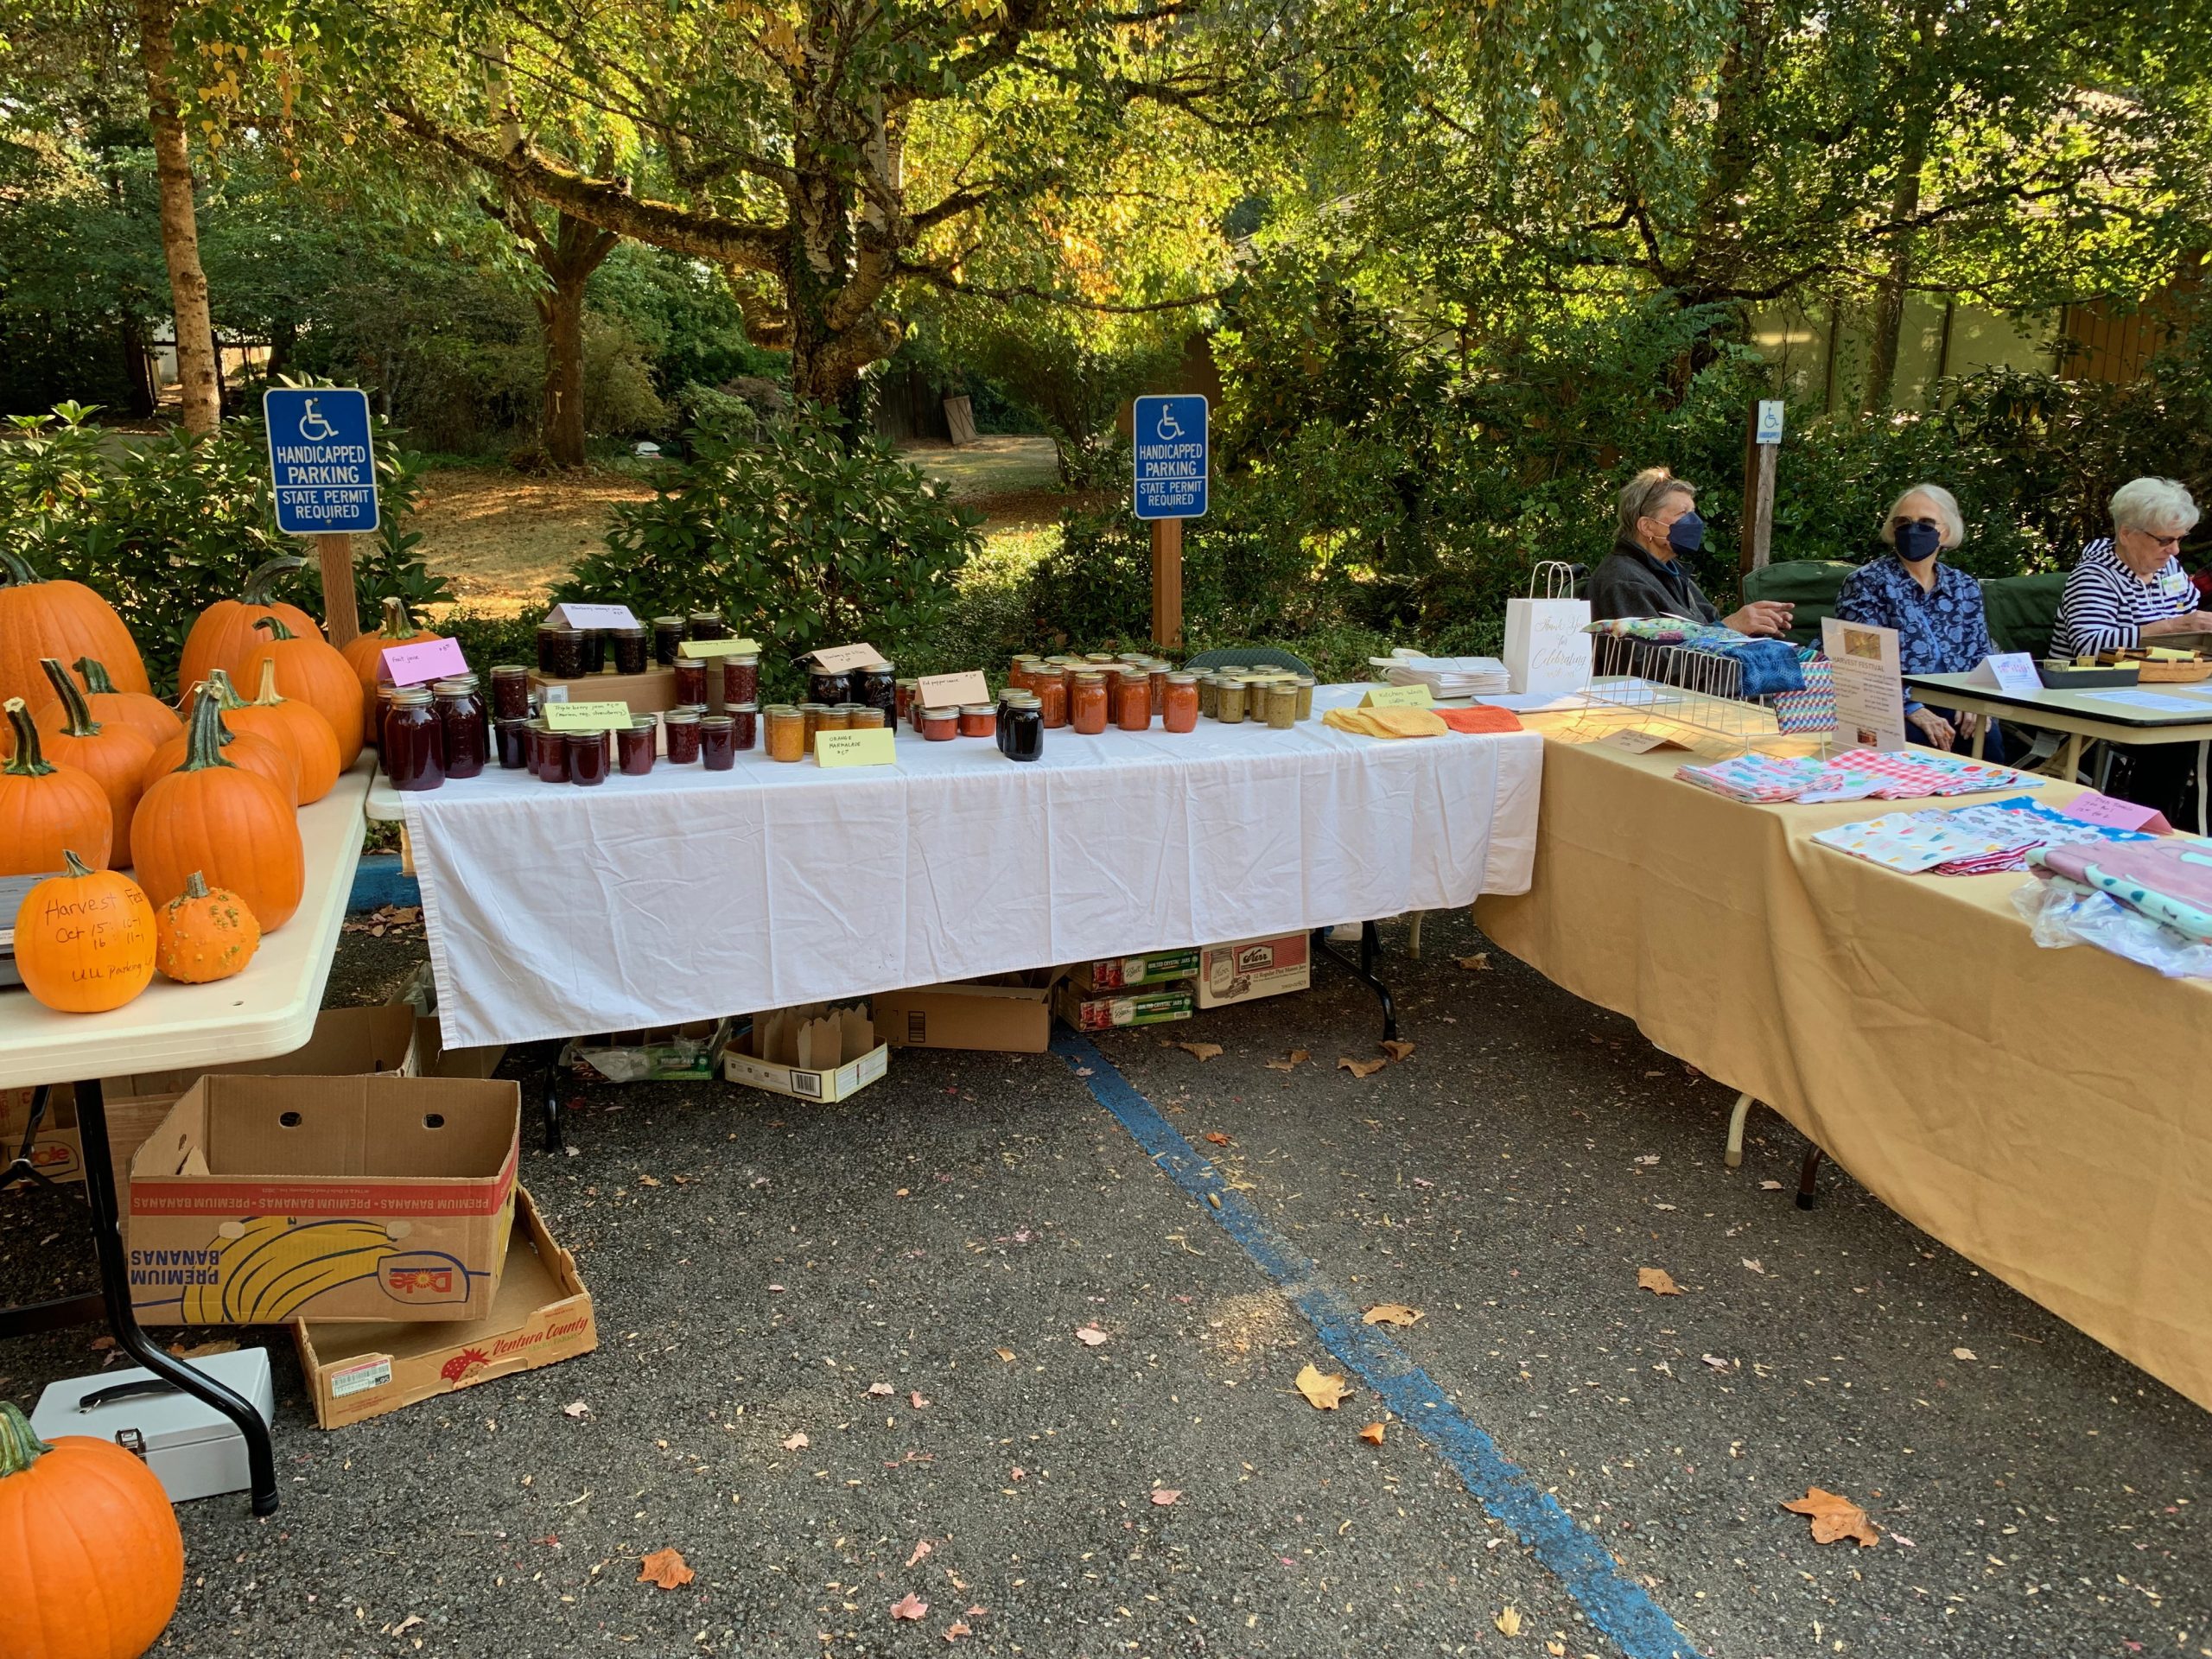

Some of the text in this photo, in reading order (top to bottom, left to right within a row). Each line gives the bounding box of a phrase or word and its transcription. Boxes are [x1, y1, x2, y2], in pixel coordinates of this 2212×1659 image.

[276, 446, 365, 463] HANDICAPPED
[1140, 443, 1203, 460] HANDICAPPED
[288, 466, 359, 484] PARKING
[1146, 461, 1197, 477] PARKING
[1140, 480, 1202, 494] STATE PERMIT
[283, 490, 369, 505] STATE PERMIT
[1148, 493, 1194, 506] REQUIRED
[296, 505, 359, 518] REQUIRED
[1535, 615, 1564, 632] Thank
[1531, 648, 1586, 671] Celebrating
[1832, 657, 1885, 672] HARVEST FESTIVAL
[45, 893, 118, 925] Harvest
[56, 926, 85, 943] Oct
[1243, 949, 1268, 963] Kerr
[31, 1147, 69, 1164] ole
[134, 1198, 489, 1209] PREMIUM BANANAS PREMIUM BANANAS PREMIUM BANANAS
[130, 1249, 219, 1266] BANANAS
[130, 1269, 219, 1285] PREMIUM
[389, 1271, 452, 1294] Dole
[493, 1316, 588, 1356] Ventura County
